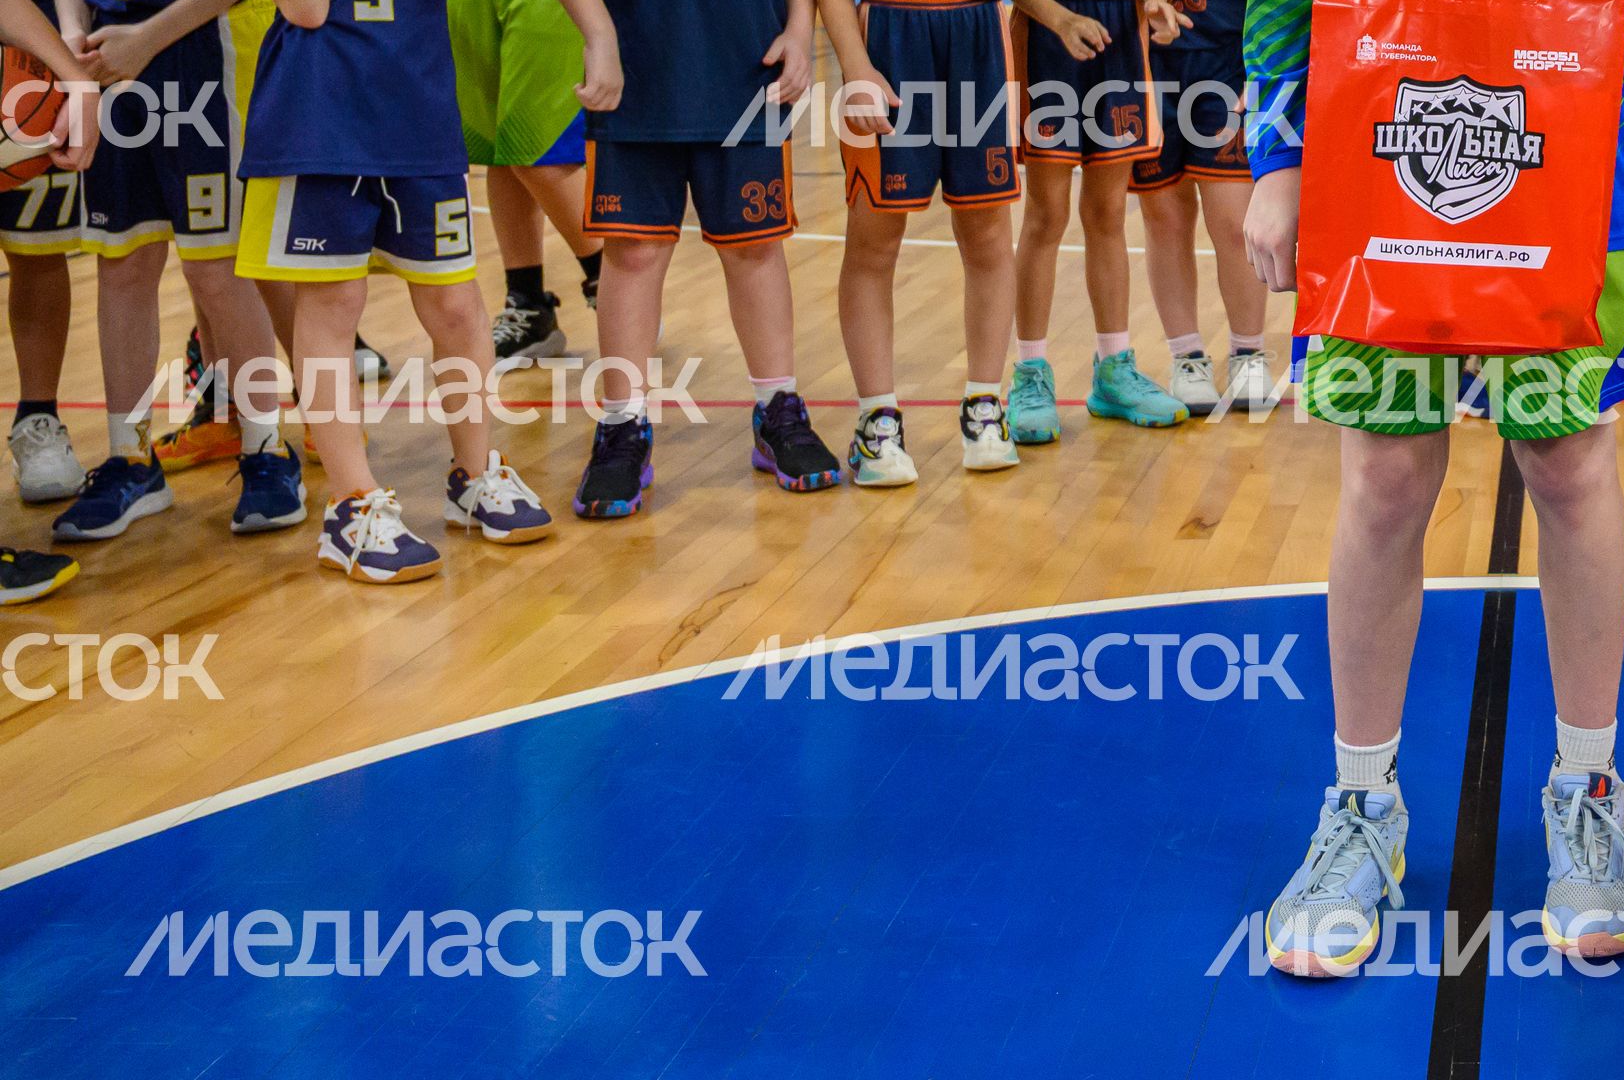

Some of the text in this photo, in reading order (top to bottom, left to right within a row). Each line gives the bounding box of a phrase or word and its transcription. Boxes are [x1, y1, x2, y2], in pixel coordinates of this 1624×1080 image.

[1380, 53, 1438, 63] ГУБЕРНАТОРА
[1381, 42, 1423, 52] КОМАНДА
[1513, 59, 1578, 71] СПОРТ
[1514, 49, 1579, 61] МОСОБЛ
[1110, 104, 1143, 145] 15
[1376, 119, 1542, 164] ШКОЛЬНАЯ
[985, 146, 1009, 186] 5
[1427, 119, 1507, 184] Лига
[12, 171, 79, 229] 77
[186, 172, 226, 231] 9
[741, 178, 786, 223] 33
[292, 237, 328, 252] STK
[434, 197, 470, 257] 5
[1380, 242, 1531, 263] ШКОЛЬНАЯЛИГА.РФ
